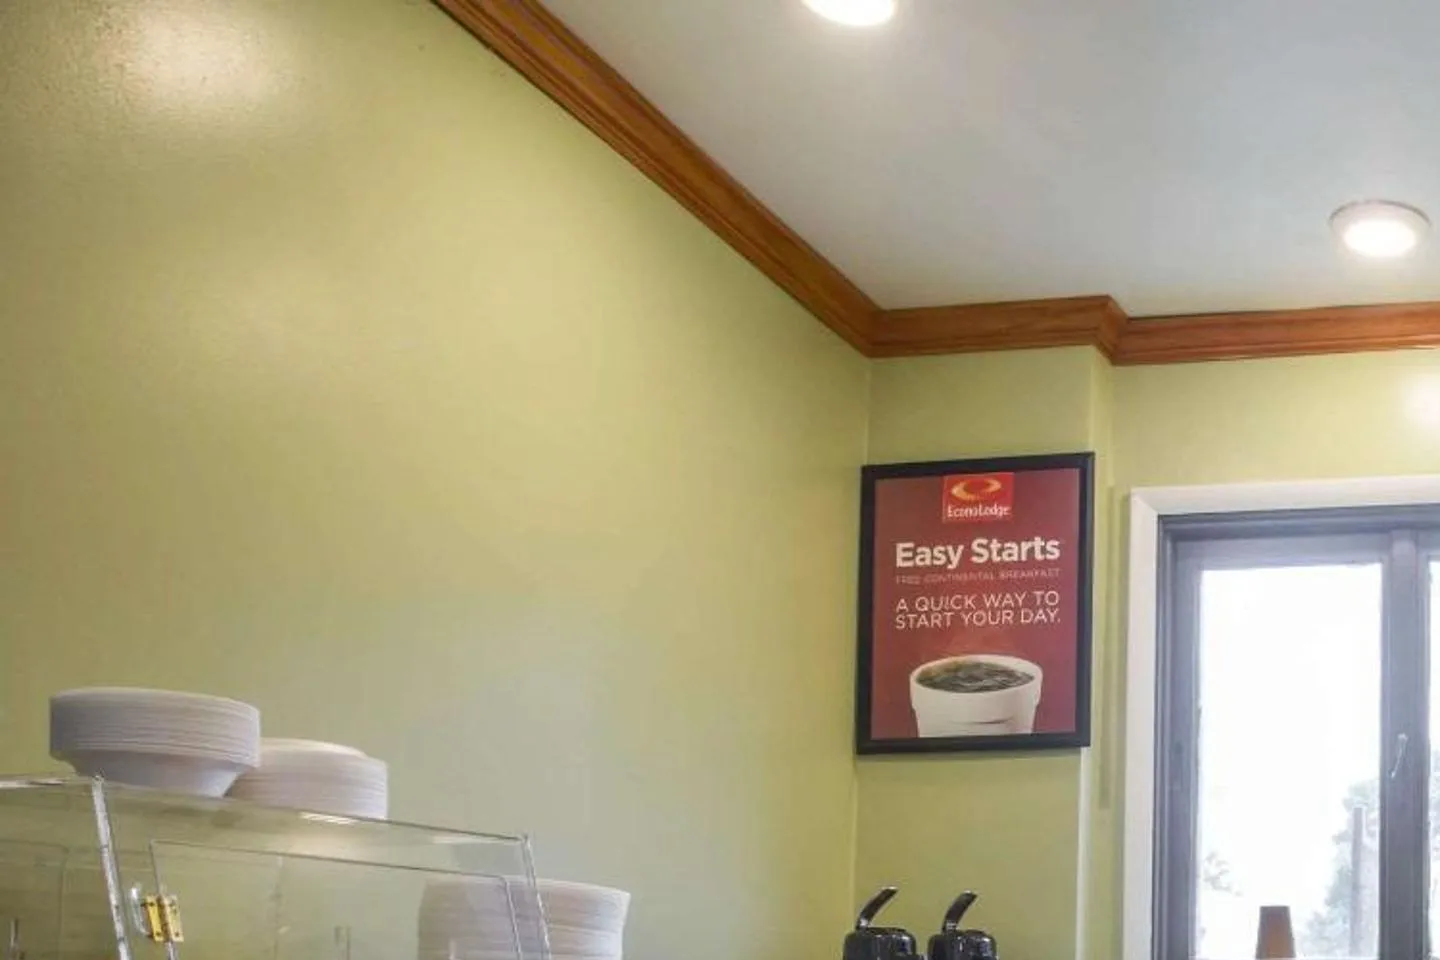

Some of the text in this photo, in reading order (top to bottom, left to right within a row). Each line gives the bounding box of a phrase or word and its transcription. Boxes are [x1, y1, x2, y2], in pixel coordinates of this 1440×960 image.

[896, 536, 1060, 569] Easy Starts
[896, 590, 1060, 613] A QUICK WAY TO
[895, 607, 1061, 630] START YOUR DAY.
